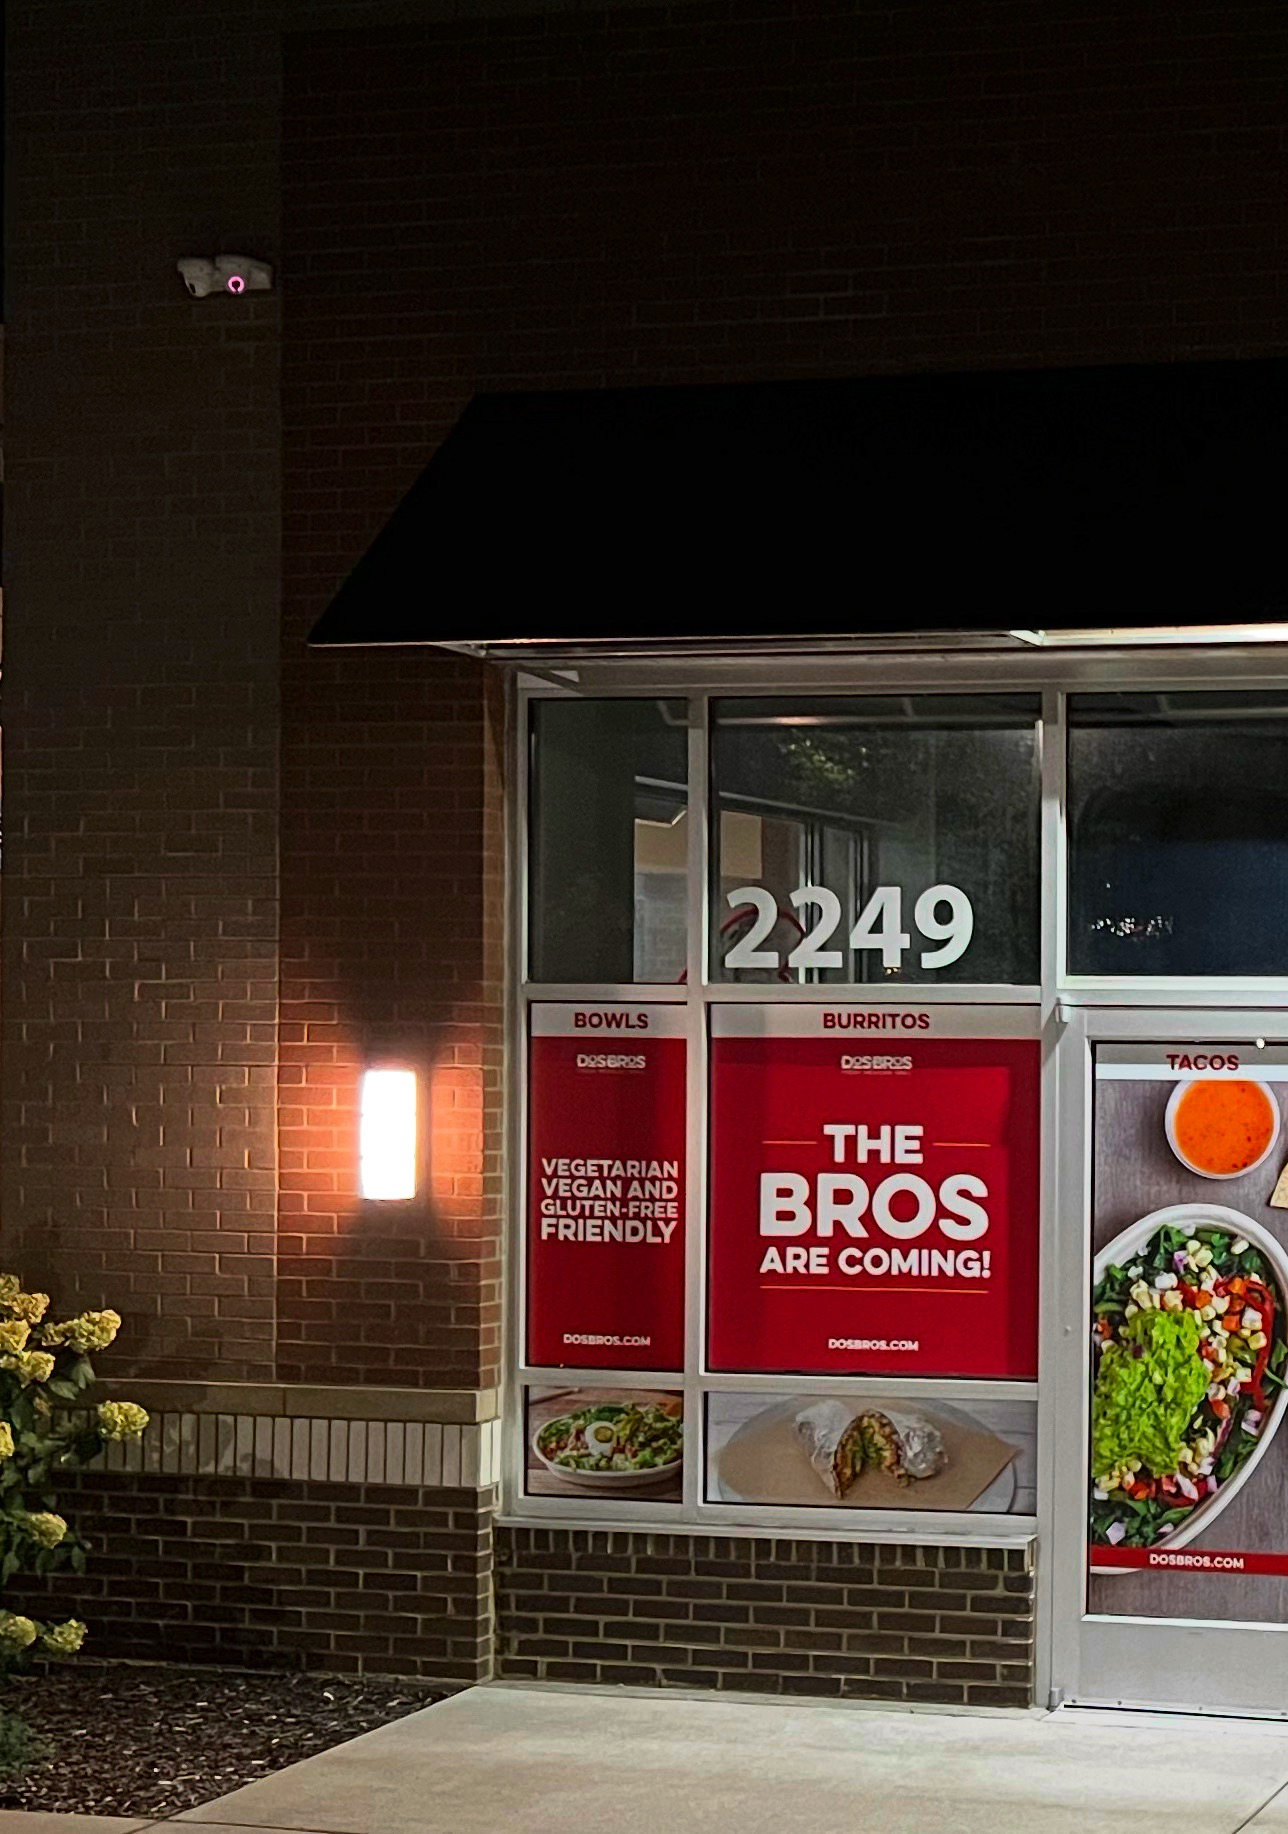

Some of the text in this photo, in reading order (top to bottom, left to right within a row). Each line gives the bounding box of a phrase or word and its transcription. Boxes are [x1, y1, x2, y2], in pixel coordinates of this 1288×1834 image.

[724, 884, 975, 969] 2249
[574, 1012, 649, 1030] BOWLS
[823, 1012, 930, 1030] BURRITOS
[1166, 1051, 1240, 1071] TACOS
[823, 1124, 924, 1164] THE
[541, 1158, 679, 1179] VEGETARIAN
[541, 1179, 678, 1199] VEGAN AND
[540, 1199, 679, 1218] GLUTEN-FREE
[759, 1172, 989, 1241] BROS
[540, 1217, 678, 1243] FRIENDLY
[759, 1246, 991, 1279] ARE COMING!
[563, 1333, 651, 1346] DOSBROS.COM
[828, 1338, 919, 1351] DOSBROS.COM
[1149, 1552, 1244, 1569] DOSBROS.COM
